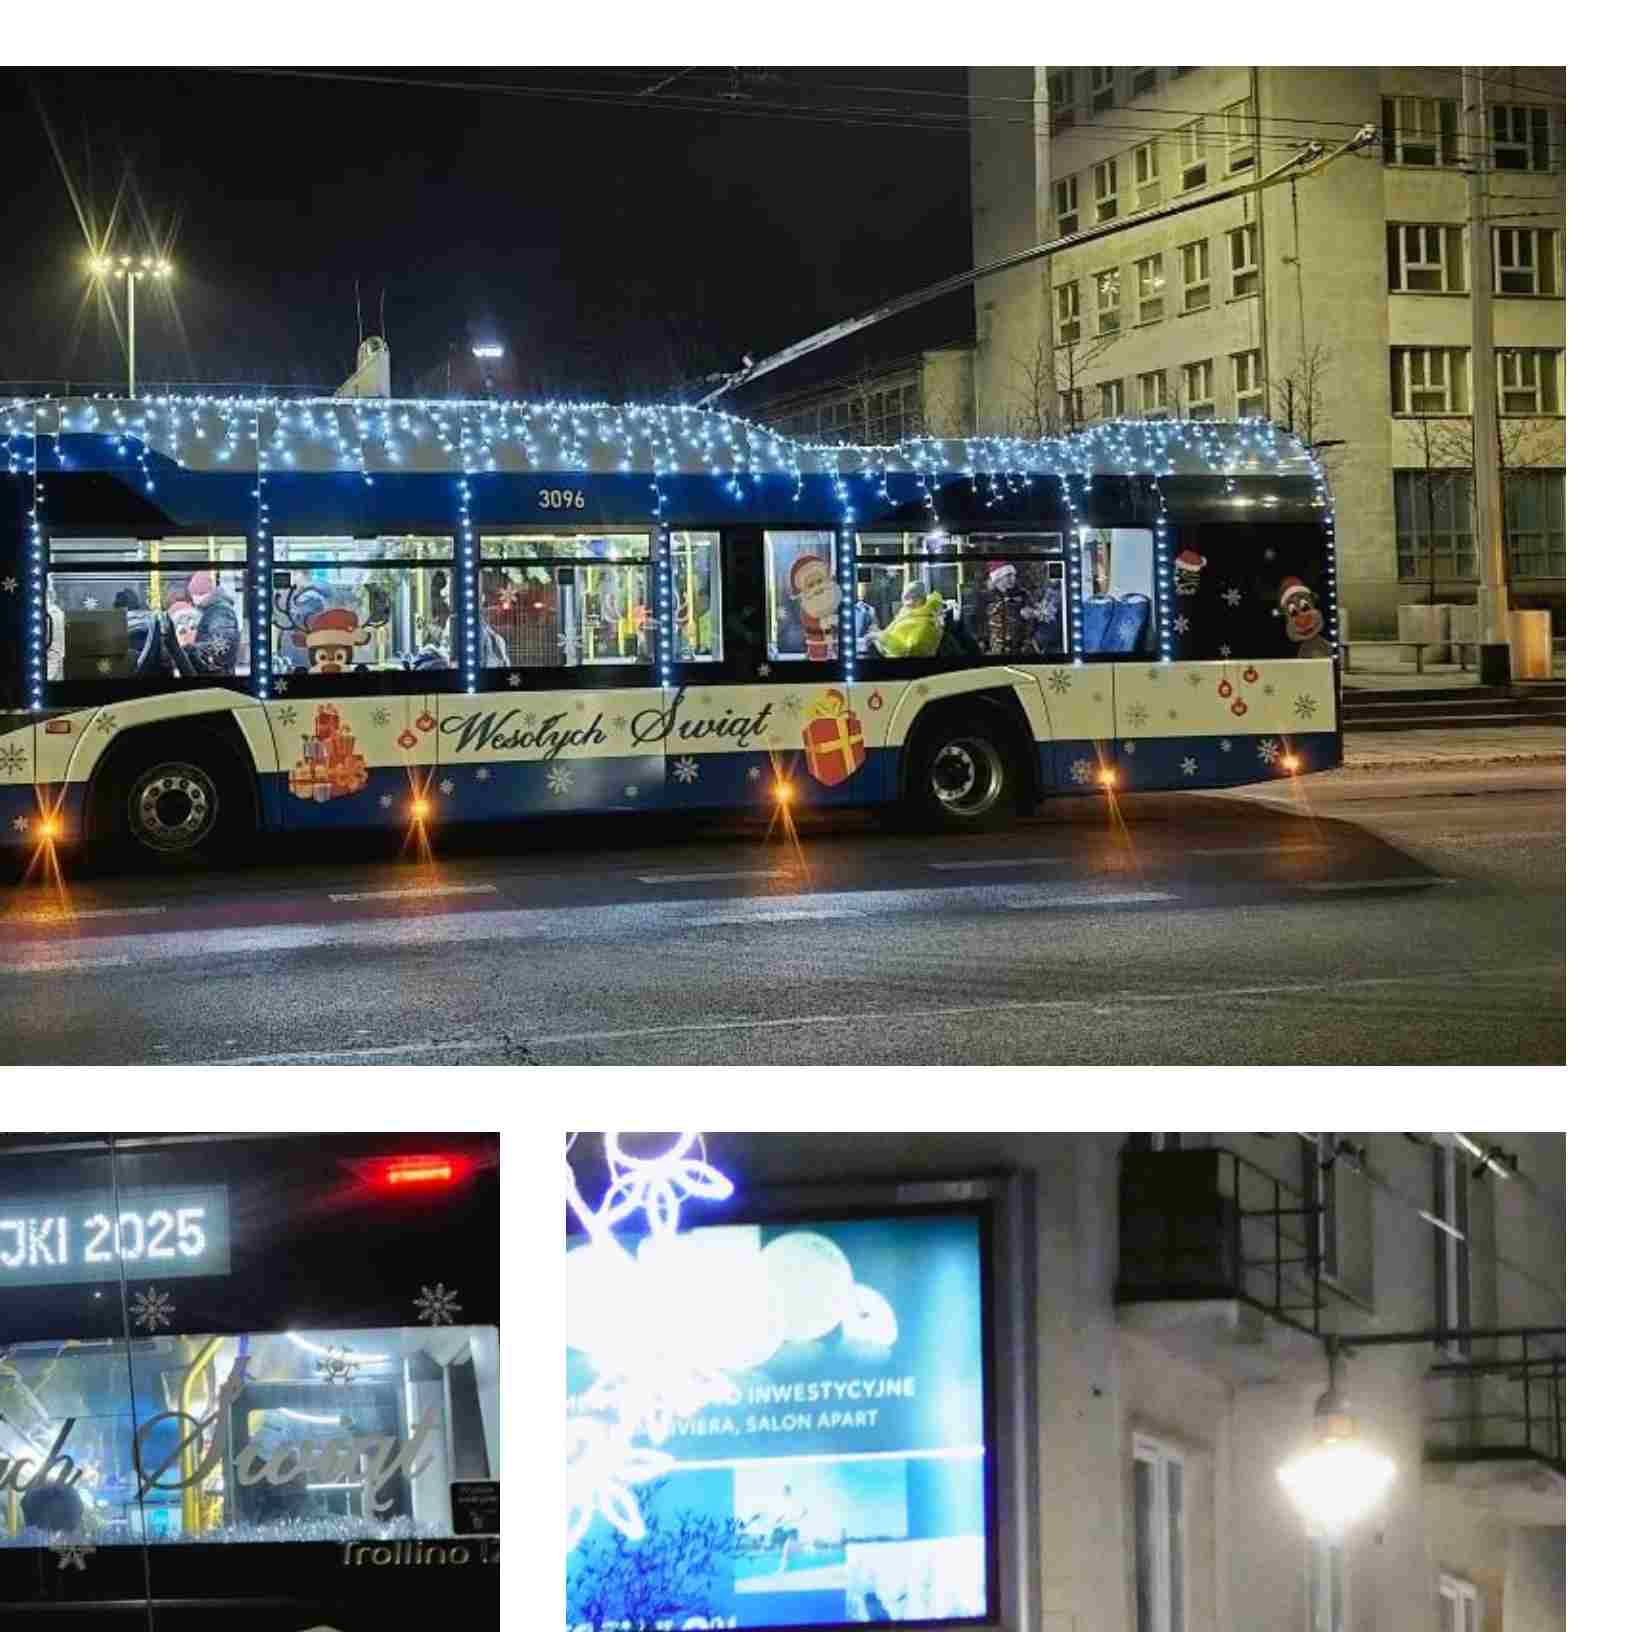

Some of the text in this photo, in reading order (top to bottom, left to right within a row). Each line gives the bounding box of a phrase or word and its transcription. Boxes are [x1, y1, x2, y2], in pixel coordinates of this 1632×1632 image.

[538, 489, 585, 509] 3096
[440, 709, 607, 760] Wesołych
[84, 1208, 207, 1263] 2025
[748, 1376, 917, 1405] INWESTYCYJNE
